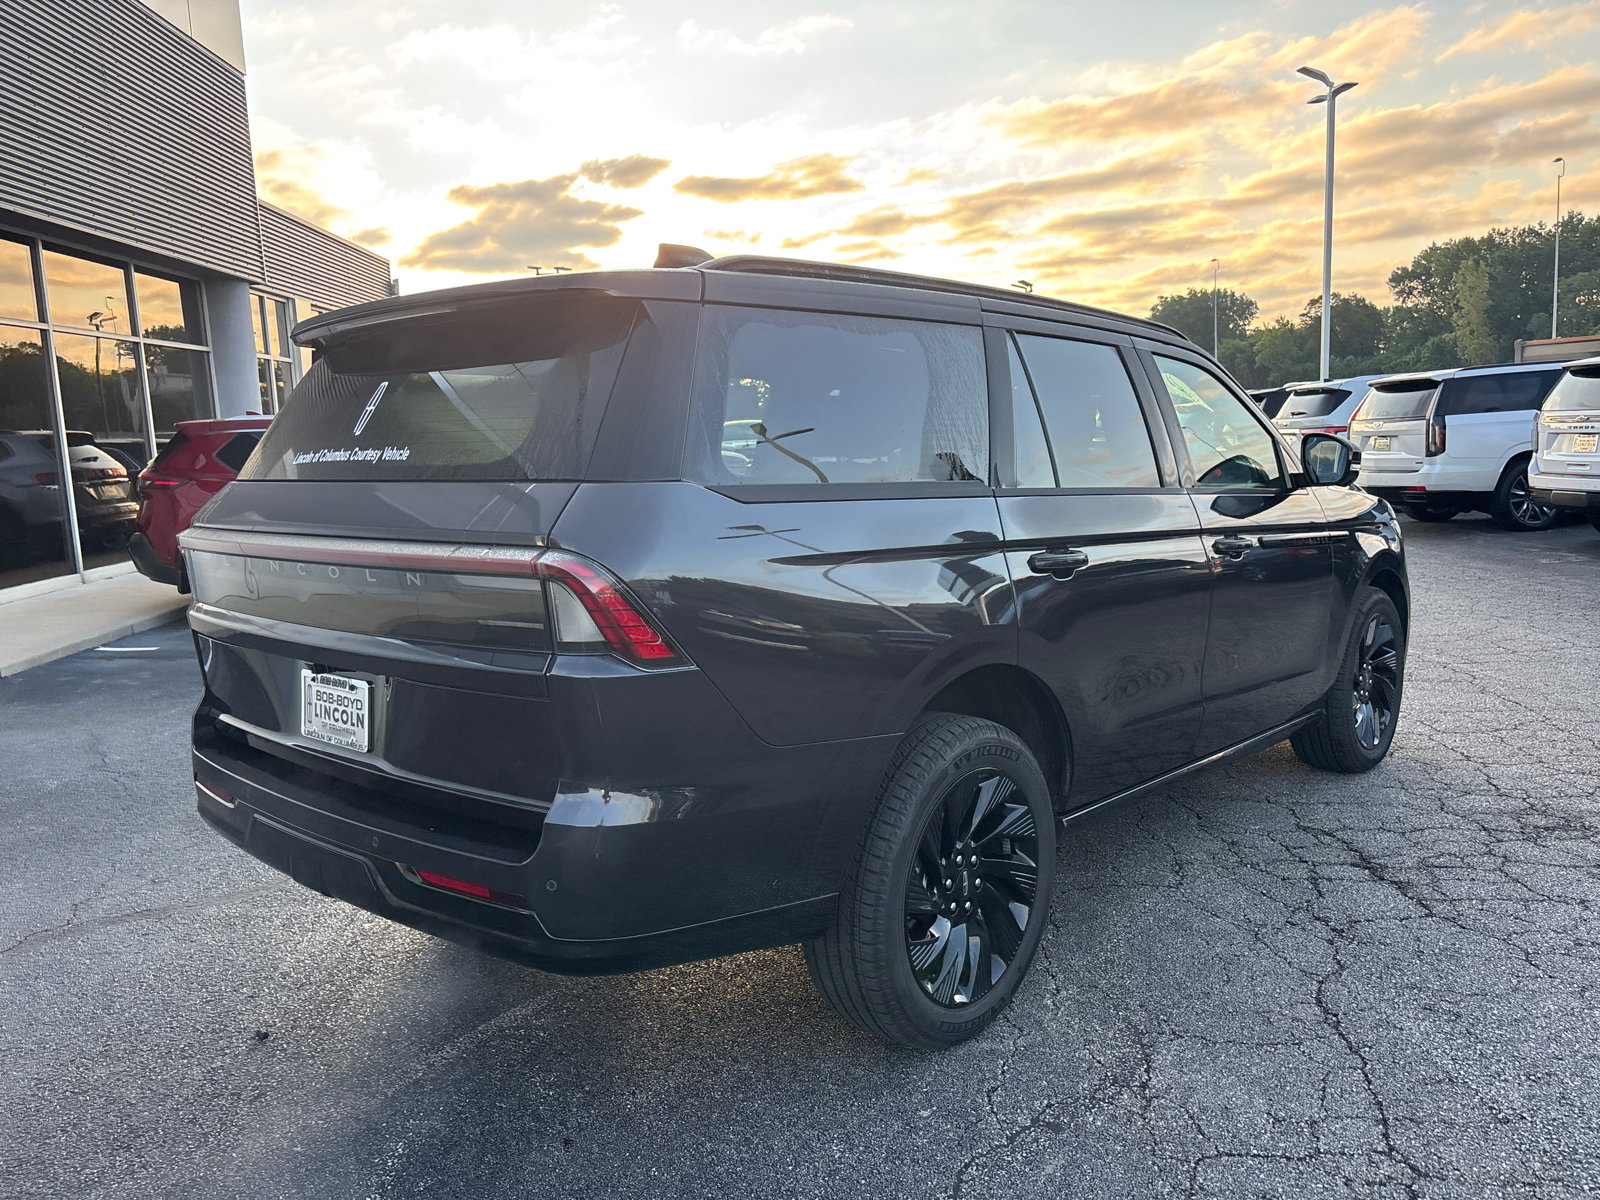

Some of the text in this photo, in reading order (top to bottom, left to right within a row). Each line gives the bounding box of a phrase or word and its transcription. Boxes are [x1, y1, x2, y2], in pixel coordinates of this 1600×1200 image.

[293, 446, 410, 464] Lincoln of Columbus Courtesy Vehicle
[223, 556, 422, 586] LINCOLN
[316, 690, 363, 711] BOB-BOYD
[314, 702, 365, 729] LINCOLN
[304, 729, 325, 740] LINCOLN
[334, 737, 363, 751] COLUMBUS
[969, 744, 1020, 762] MICHELIN
